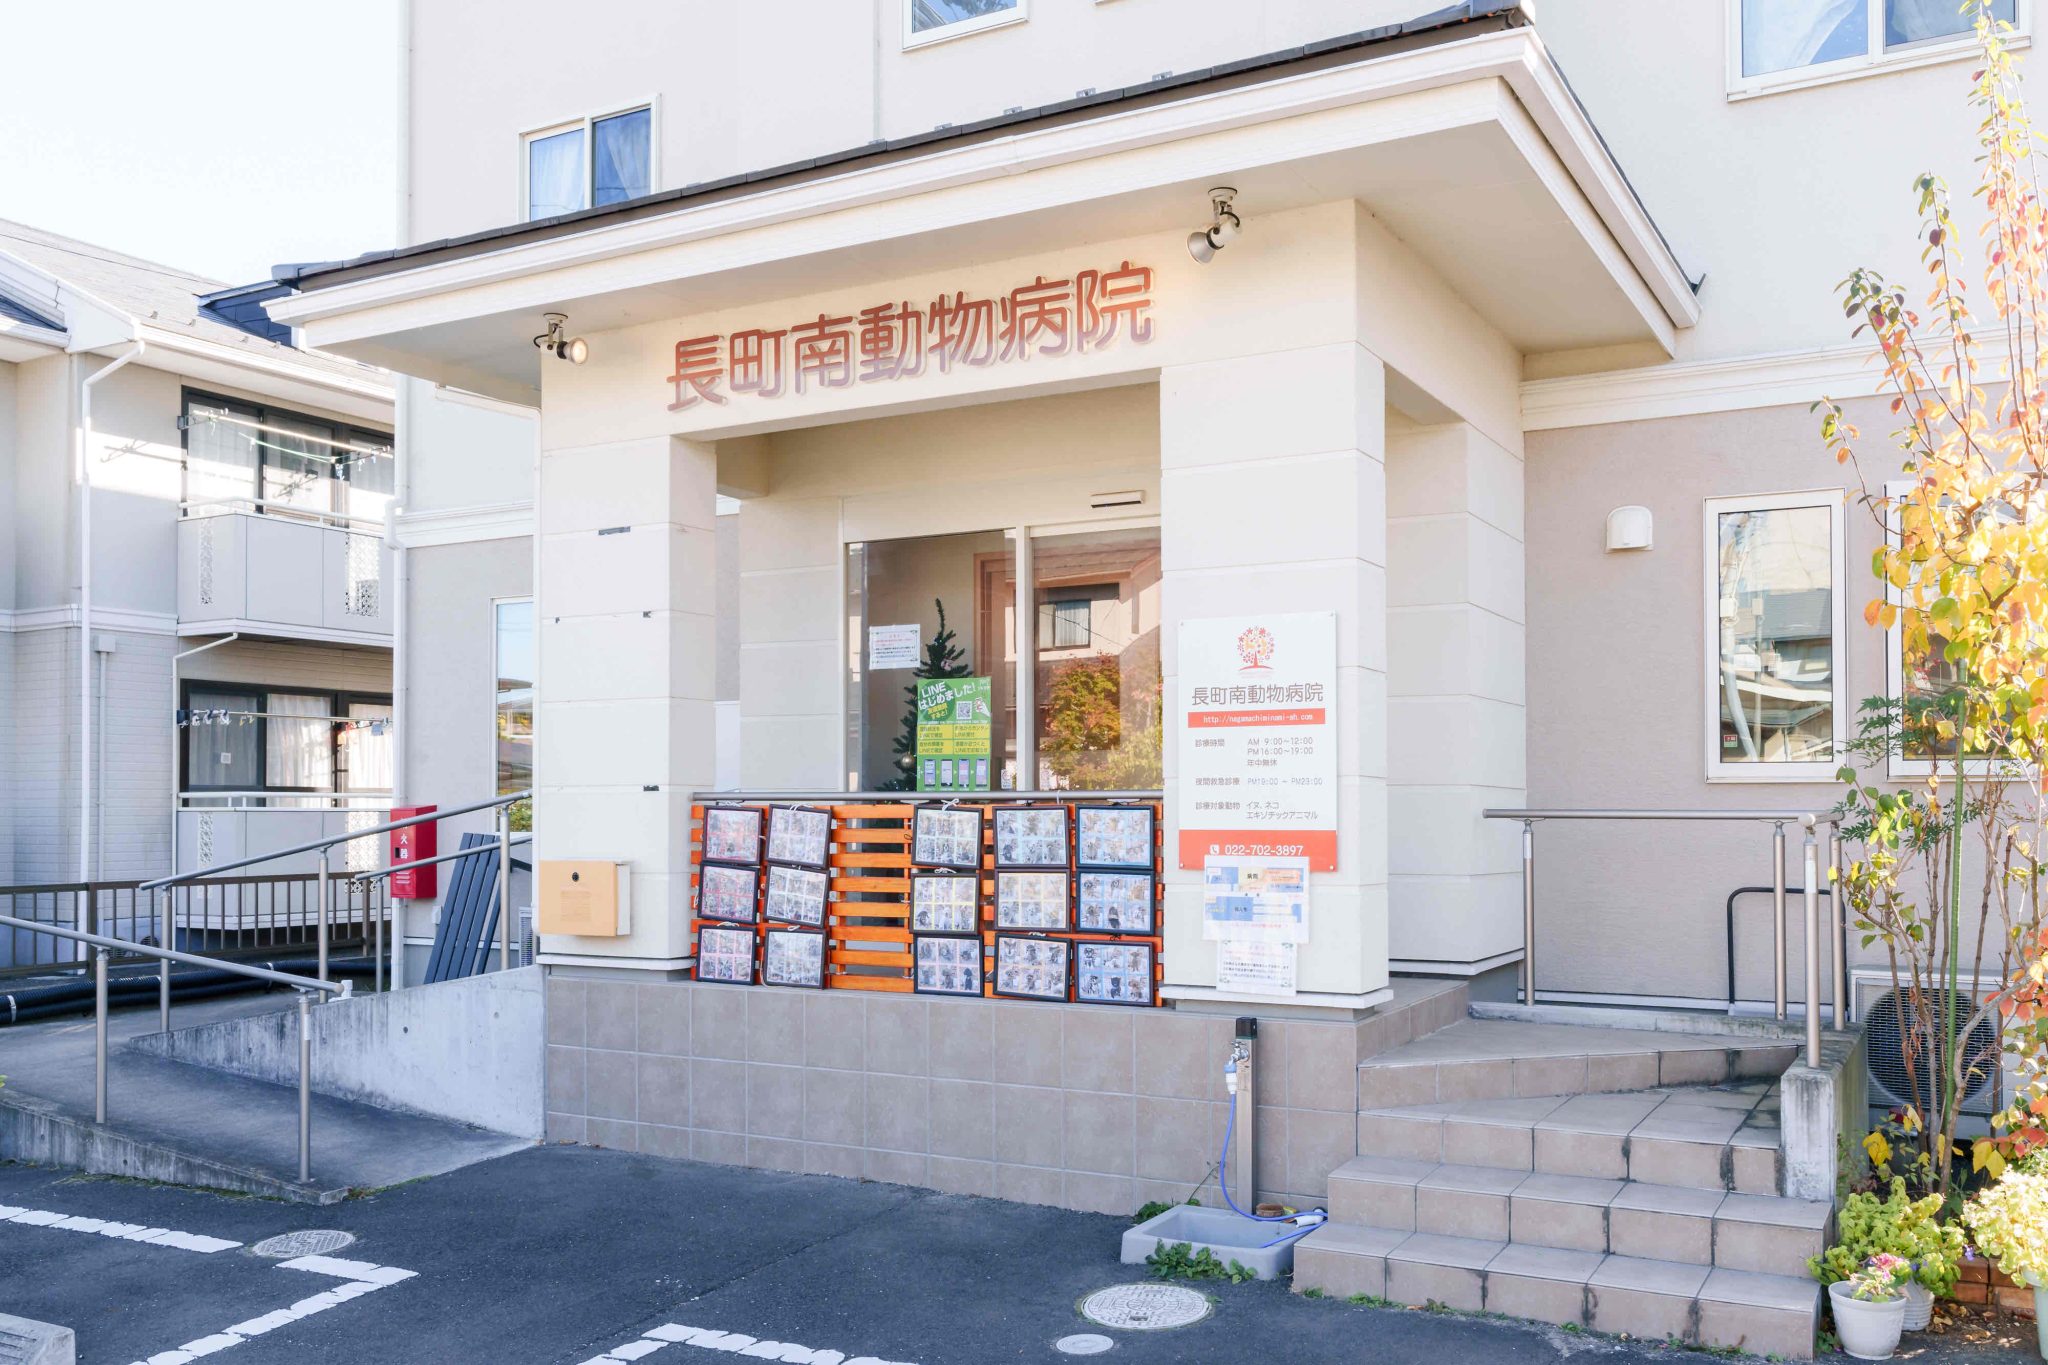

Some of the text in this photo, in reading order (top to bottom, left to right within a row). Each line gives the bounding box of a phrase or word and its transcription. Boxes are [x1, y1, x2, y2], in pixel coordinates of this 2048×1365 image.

[667, 261, 1152, 411] 長町南動物病院
[921, 681, 946, 698] LINE
[1192, 682, 1324, 705] 長町南動物病院
[1224, 844, 1304, 855] 022-702-3897
